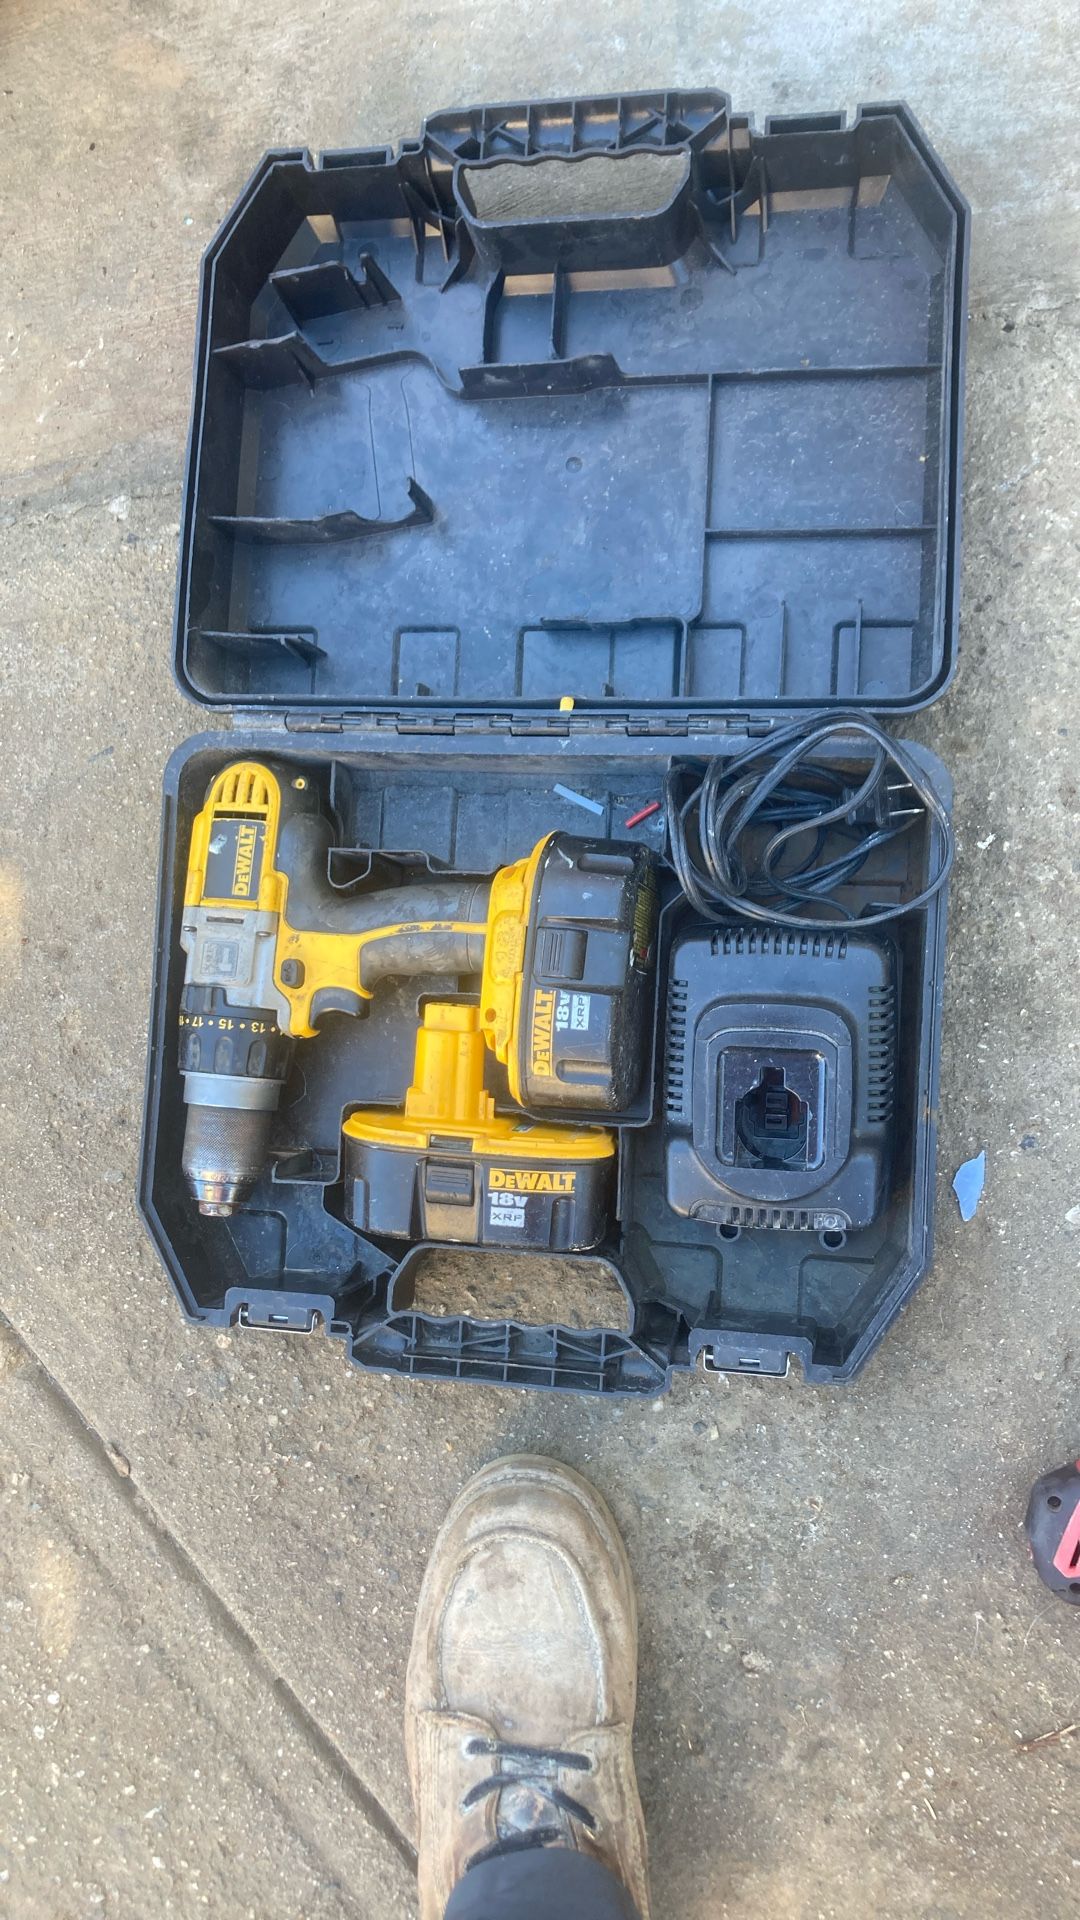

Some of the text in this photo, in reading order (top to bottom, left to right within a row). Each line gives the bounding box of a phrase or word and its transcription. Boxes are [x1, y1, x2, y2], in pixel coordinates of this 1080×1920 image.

[576, 994, 586, 1030] XRP
[191, 1016, 204, 1027] 17
[218, 1018, 234, 1030] 15
[251, 1021, 266, 1033] 13
[491, 1212, 523, 1222] XRP
